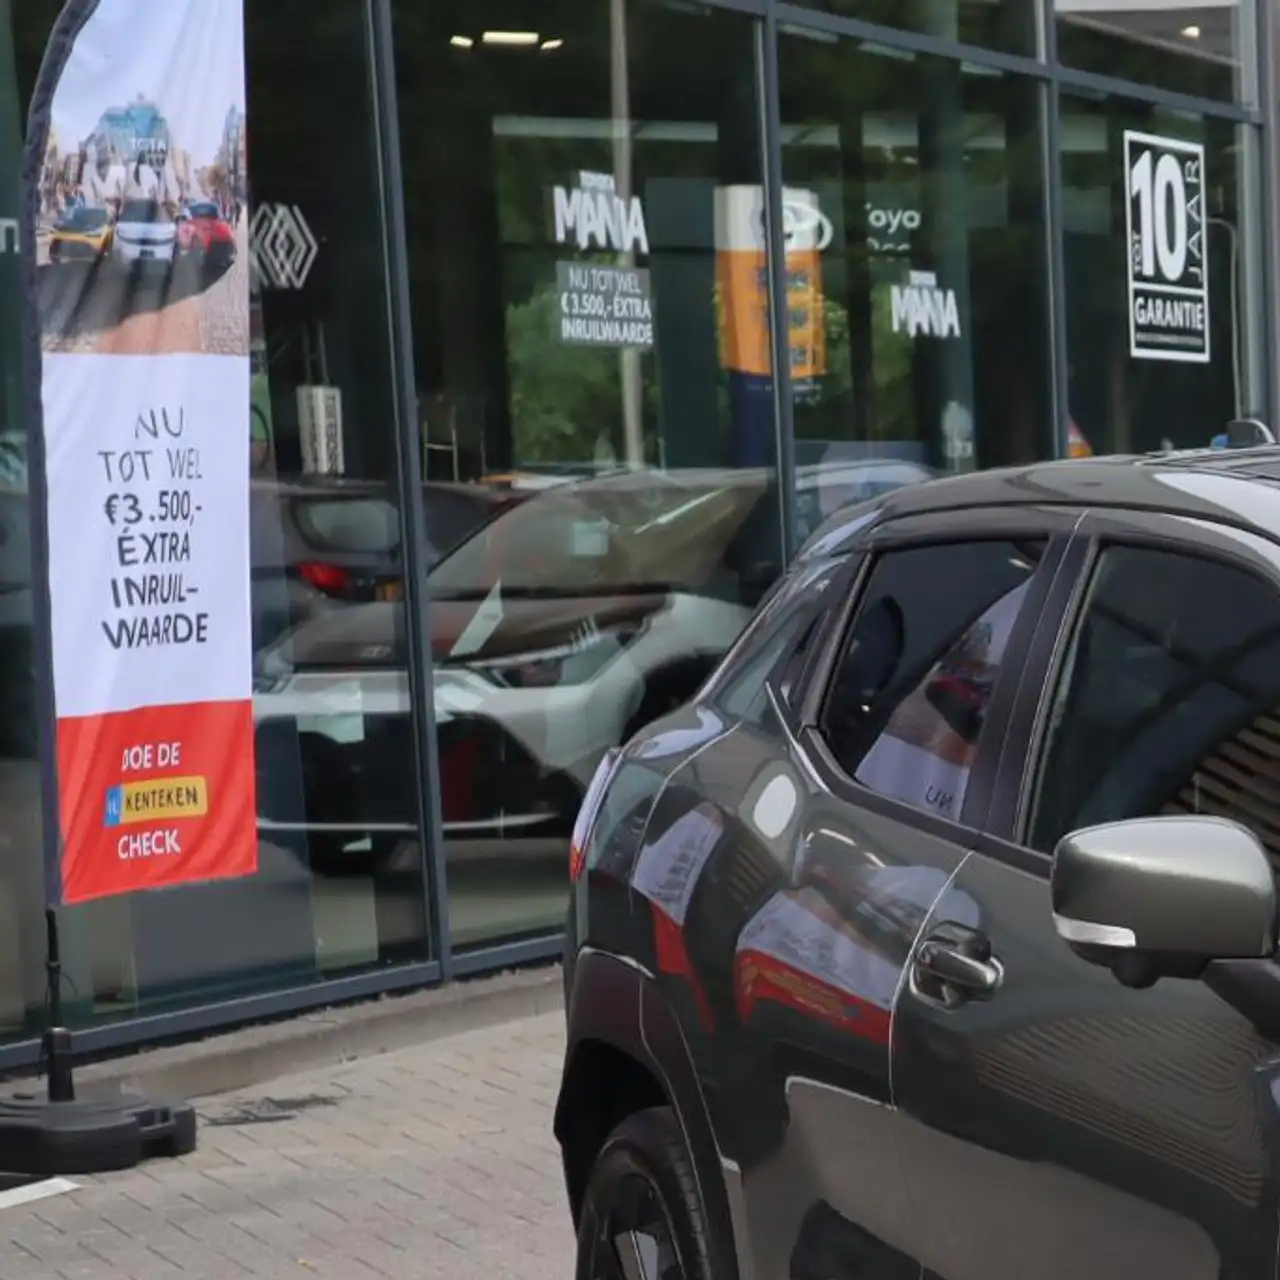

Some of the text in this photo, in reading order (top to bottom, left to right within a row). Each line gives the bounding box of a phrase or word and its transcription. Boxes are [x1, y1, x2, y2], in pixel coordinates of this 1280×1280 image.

[553, 185, 649, 255] MANIA
[1131, 149, 1187, 281] 10
[1185, 160, 1201, 282] JAAR
[569, 267, 642, 294] NU TOT WEL
[562, 317, 653, 344] INRUILWAARDE
[1135, 297, 1203, 330] GARANTIE
[134, 405, 184, 440] NU
[97, 447, 203, 483] TOT WEL
[117, 527, 191, 567] ÉXTRA
[111, 573, 199, 609] INRUIL-
[101, 612, 209, 650] WAARDE
[158, 741, 181, 767] DE
[125, 786, 199, 813] KENTEKEN
[117, 828, 181, 860] CHECK
